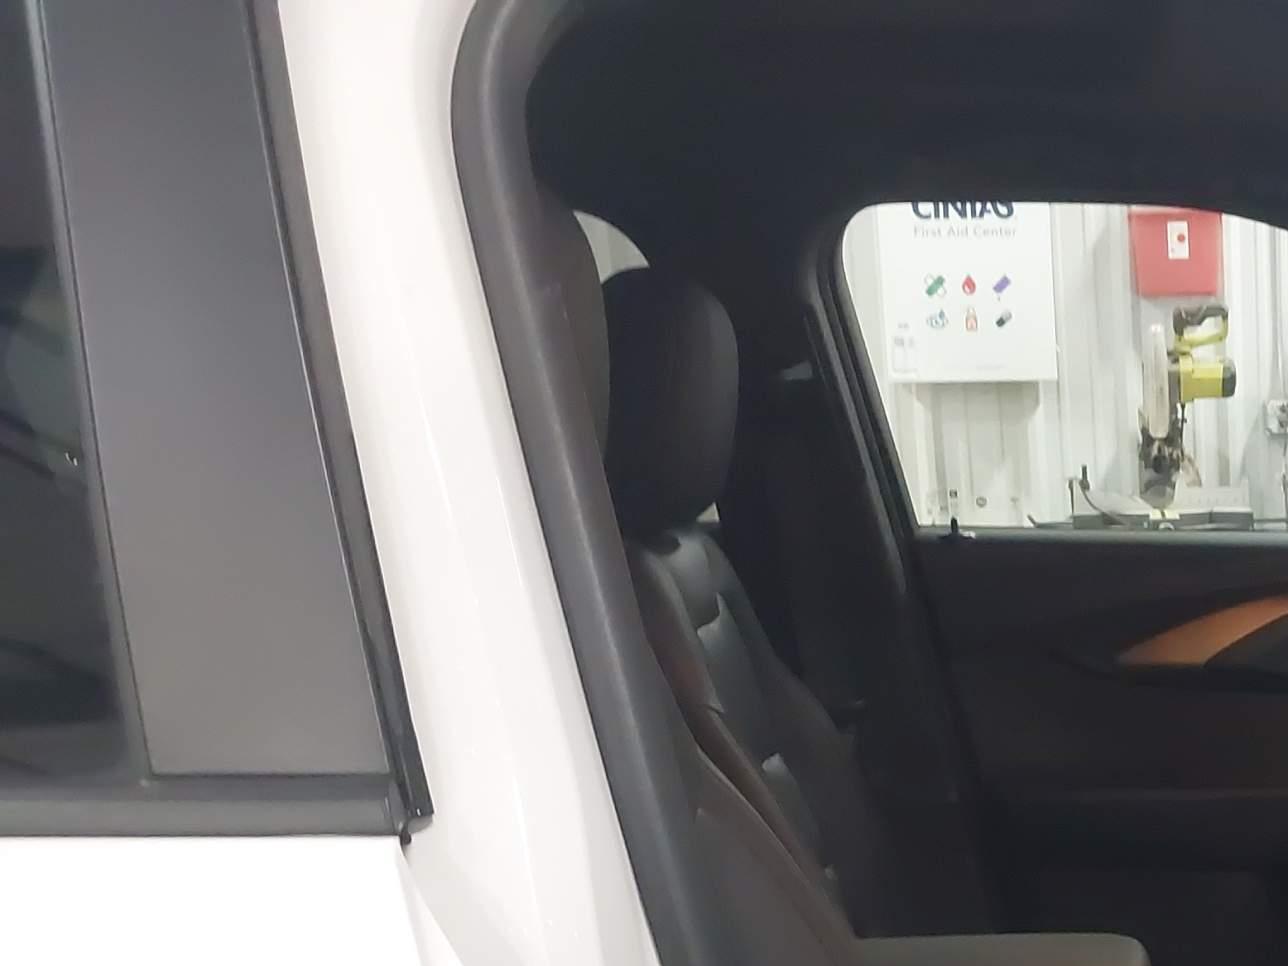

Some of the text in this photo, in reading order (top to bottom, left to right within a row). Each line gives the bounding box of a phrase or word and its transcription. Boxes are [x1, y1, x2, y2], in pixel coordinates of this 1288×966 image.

[913, 224, 1017, 238] First Aid Center
